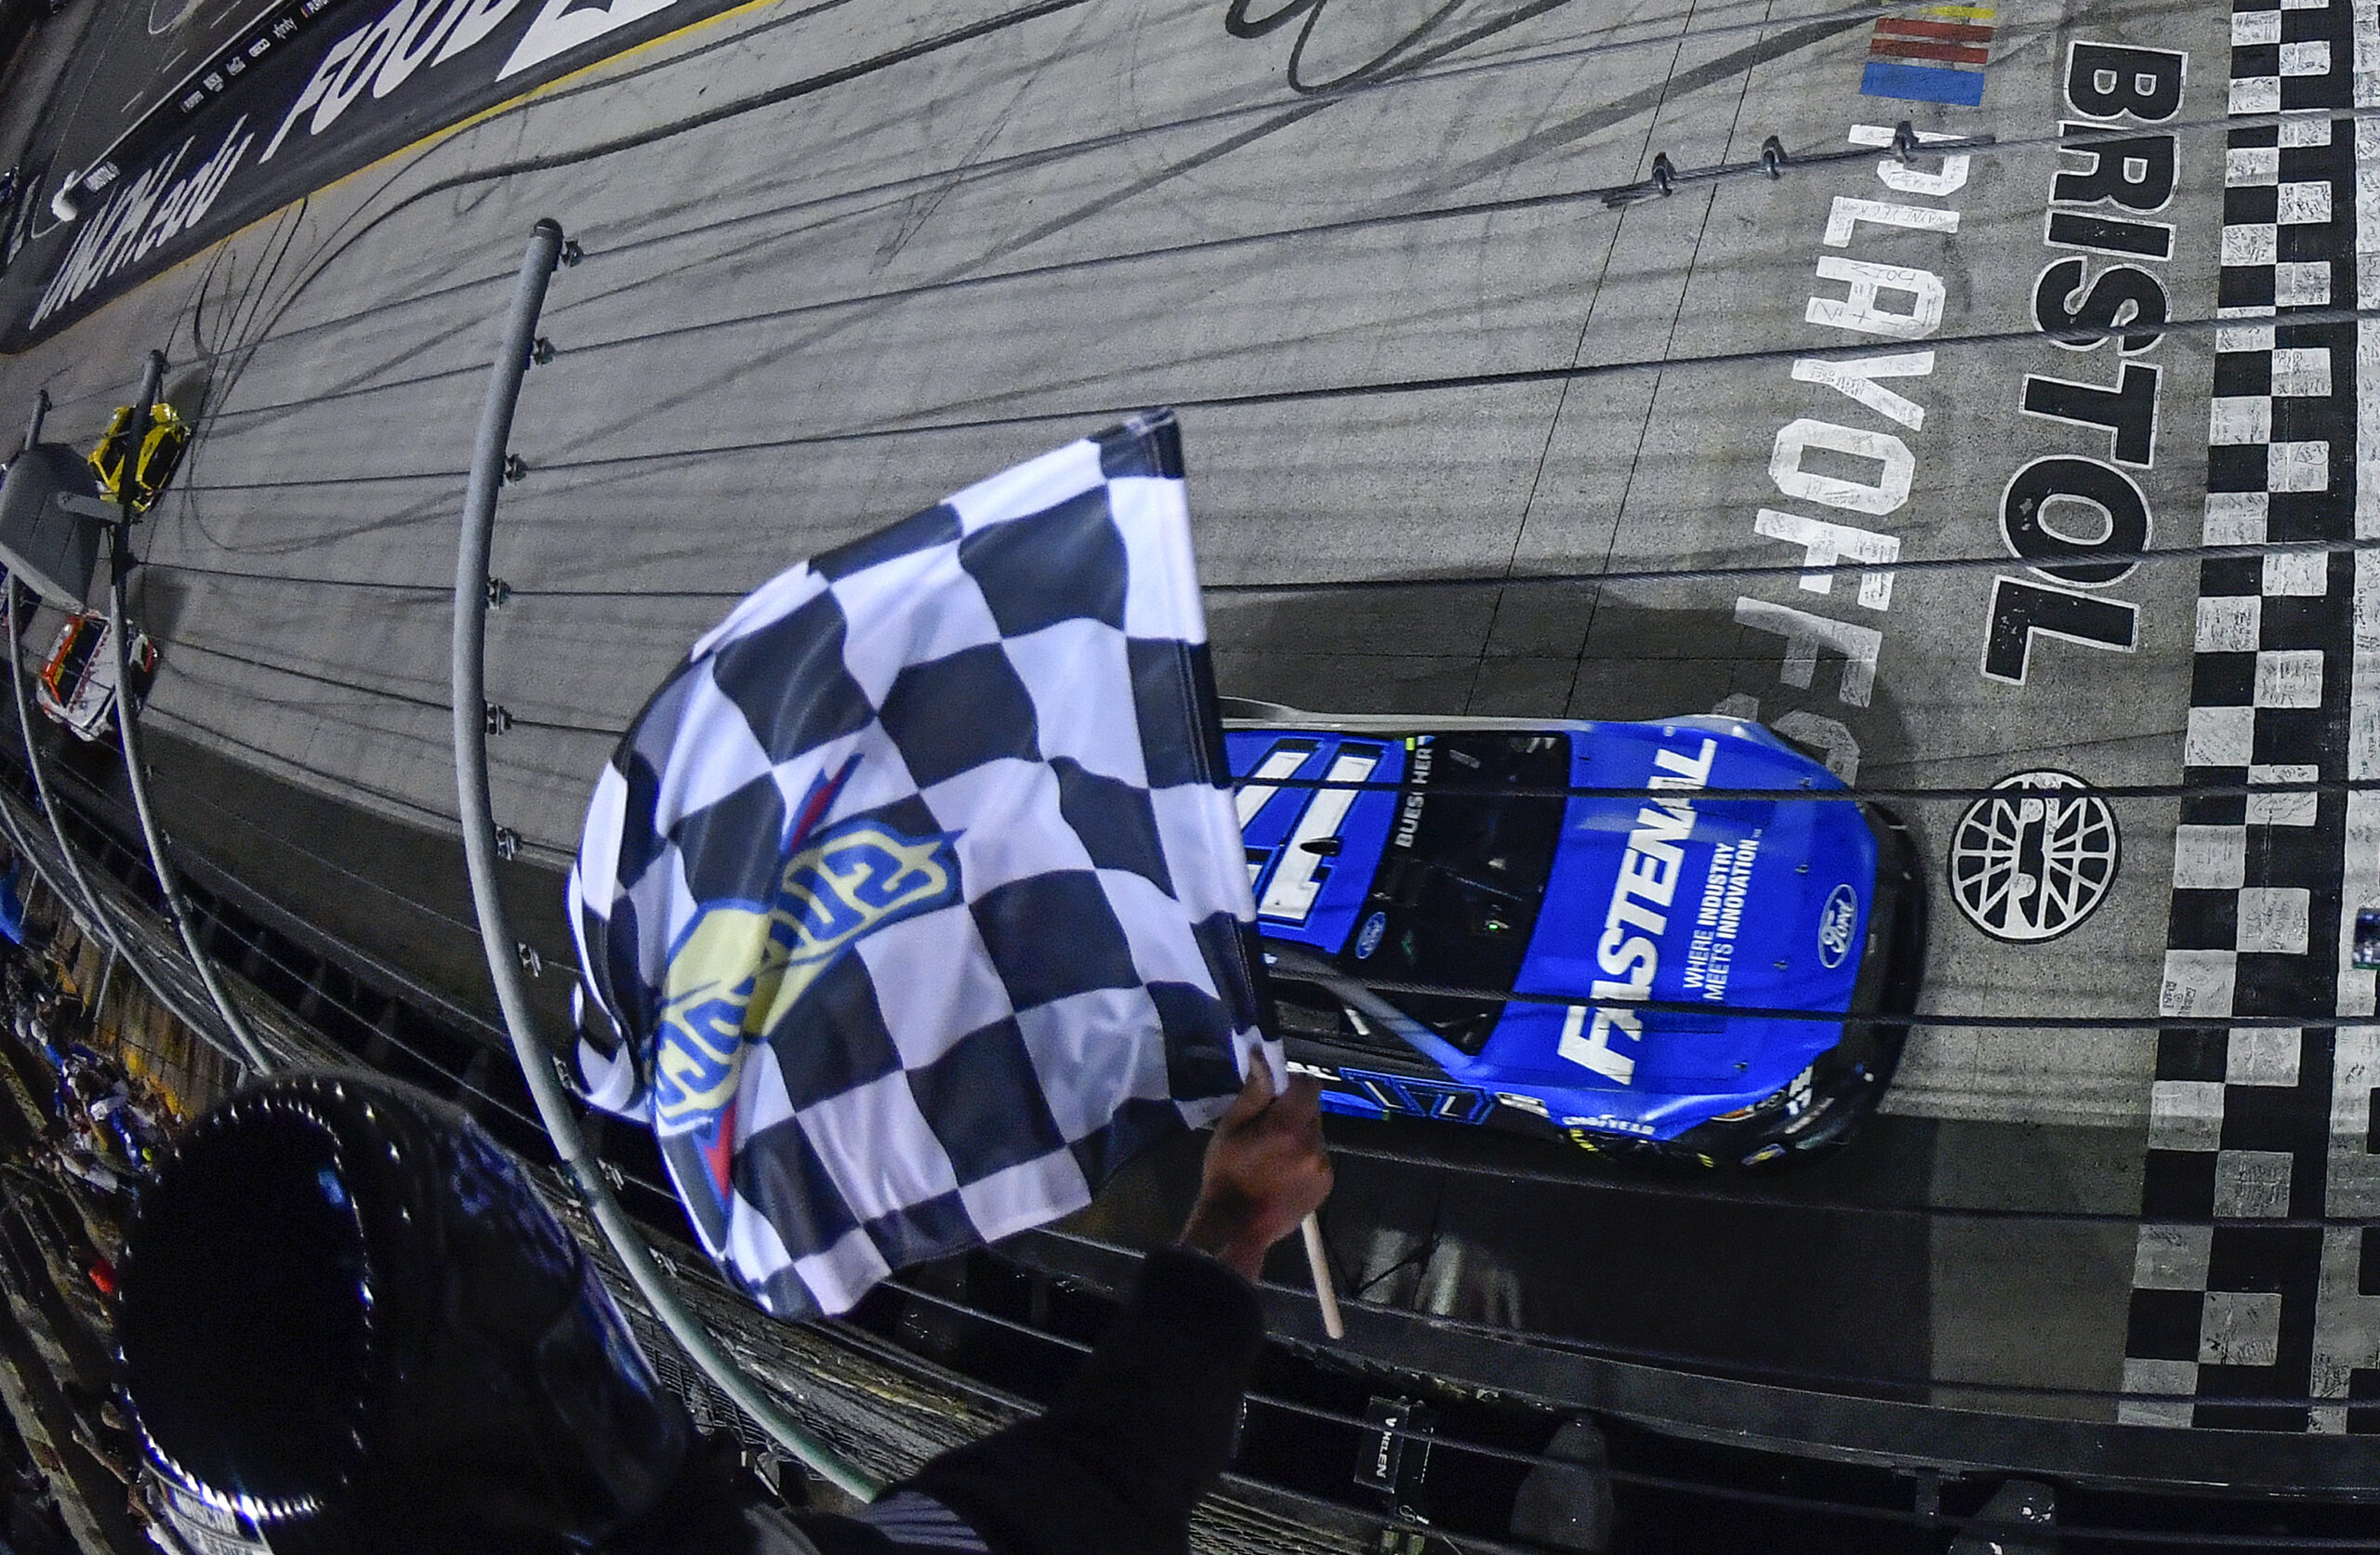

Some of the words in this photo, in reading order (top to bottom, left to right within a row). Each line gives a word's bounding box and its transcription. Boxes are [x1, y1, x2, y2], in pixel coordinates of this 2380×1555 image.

[1980, 41, 2188, 686] BRISTOL
[1395, 746, 1434, 848] BUESHER
[1557, 738, 1718, 1086] FASTENAL
[1697, 842, 1736, 926] INDUSTRY
[1716, 838, 1760, 940] INNOVATION
[1821, 898, 1855, 954] Ford
[1684, 929, 1714, 989] WHERE
[1702, 943, 1735, 1001] MEETS
